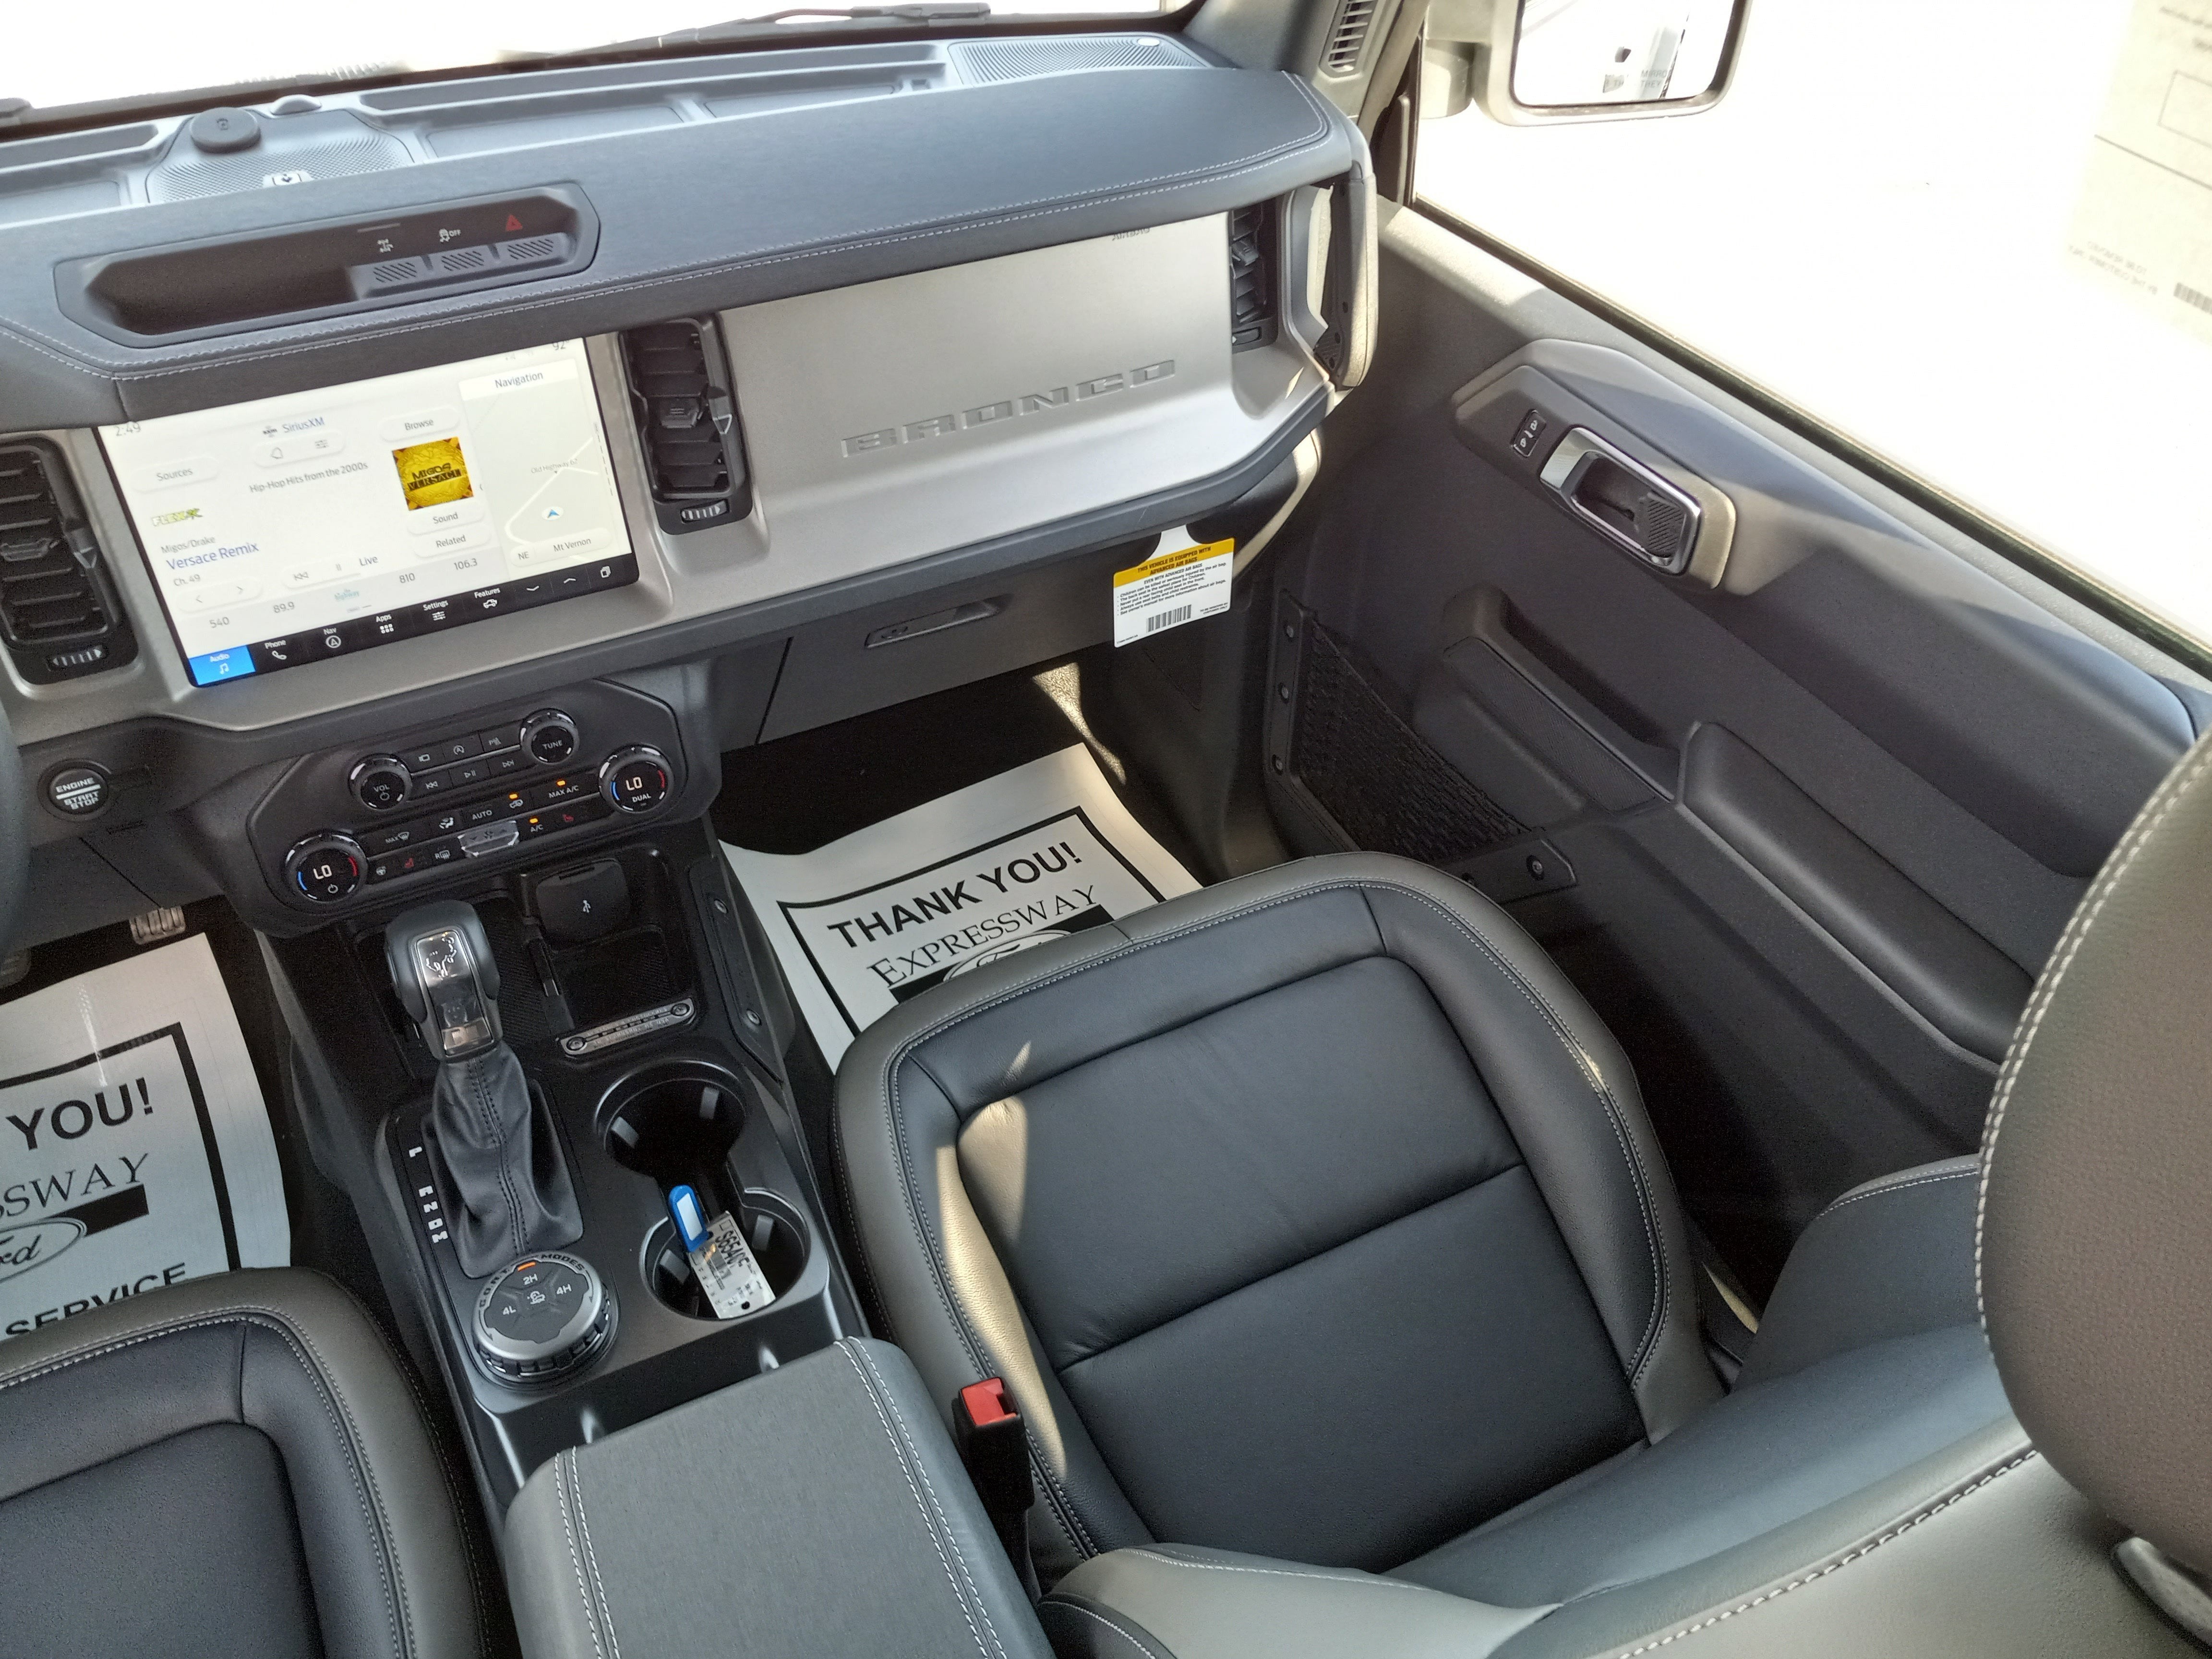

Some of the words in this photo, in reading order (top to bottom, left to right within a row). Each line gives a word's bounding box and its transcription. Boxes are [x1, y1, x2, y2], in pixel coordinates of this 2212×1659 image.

[449, 229, 461, 237] OFF
[495, 373, 543, 388] Navigation
[841, 360, 1175, 457] BRONCO
[114, 421, 141, 436] 2:49
[282, 417, 325, 433] SiriusXM
[405, 419, 433, 430] Browse
[412, 462, 451, 480] MIGOS
[543, 461, 568, 472] Highway
[156, 469, 193, 481] Sources
[249, 479, 287, 493] Hip-Hop
[287, 476, 303, 485] Hits
[304, 471, 325, 481] from
[325, 469, 340, 477] the
[340, 462, 369, 474] 2000s
[433, 511, 458, 525] Sound
[161, 536, 216, 553] Migos/Drake
[436, 535, 466, 548] Related
[553, 544, 564, 552] Mt
[565, 538, 591, 550] Vernon
[166, 553, 217, 570] Versace
[218, 542, 259, 559] Remix
[359, 556, 379, 566] Live
[518, 551, 529, 560] NE
[1149, 559, 1168, 569] VEHICLE
[1175, 550, 1198, 561] EQUIPPED
[453, 558, 478, 571] 106.3
[1149, 563, 1175, 576] ADVANCED
[399, 573, 416, 584] 810
[1165, 569, 1184, 577] ADVANCED
[173, 577, 188, 587] Ch.
[189, 574, 201, 582] 49
[474, 587, 501, 599] Features
[1120, 589, 1136, 598] Children
[1176, 587, 1197, 596] information
[273, 601, 295, 613] 89.9
[423, 600, 449, 612] Settings
[209, 617, 229, 628] 540
[375, 613, 392, 623] Apps
[324, 627, 337, 636] Nav
[264, 639, 287, 649] Phone
[209, 652, 230, 663] Audio
[541, 739, 563, 750] TUNE
[56, 777, 96, 793] ENGINE
[373, 784, 390, 793] VOL
[626, 777, 643, 791] LO
[548, 789, 565, 798] MAX
[566, 785, 580, 794] A/C
[64, 791, 99, 806] START
[71, 797, 99, 810] STOP
[632, 793, 651, 803] DUAL
[472, 810, 493, 820] AUTO
[530, 824, 544, 833] A/C
[385, 836, 398, 844] MAX
[313, 865, 332, 880] LO
[828, 879, 982, 948] THANK
[976, 841, 1083, 894] YOU!
[866, 885, 1098, 989] EXPRESSWAY
[6, 1077, 153, 1151] YOU!
[409, 1146, 422, 1158] P
[419, 1185, 433, 1197] R
[423, 1201, 438, 1213] N
[428, 1218, 443, 1230] D
[432, 1230, 448, 1243] M
[541, 1254, 585, 1271] MODES
[523, 1274, 538, 1286] 2H
[556, 1284, 572, 1295] 4H
[503, 1306, 517, 1315] 4L
